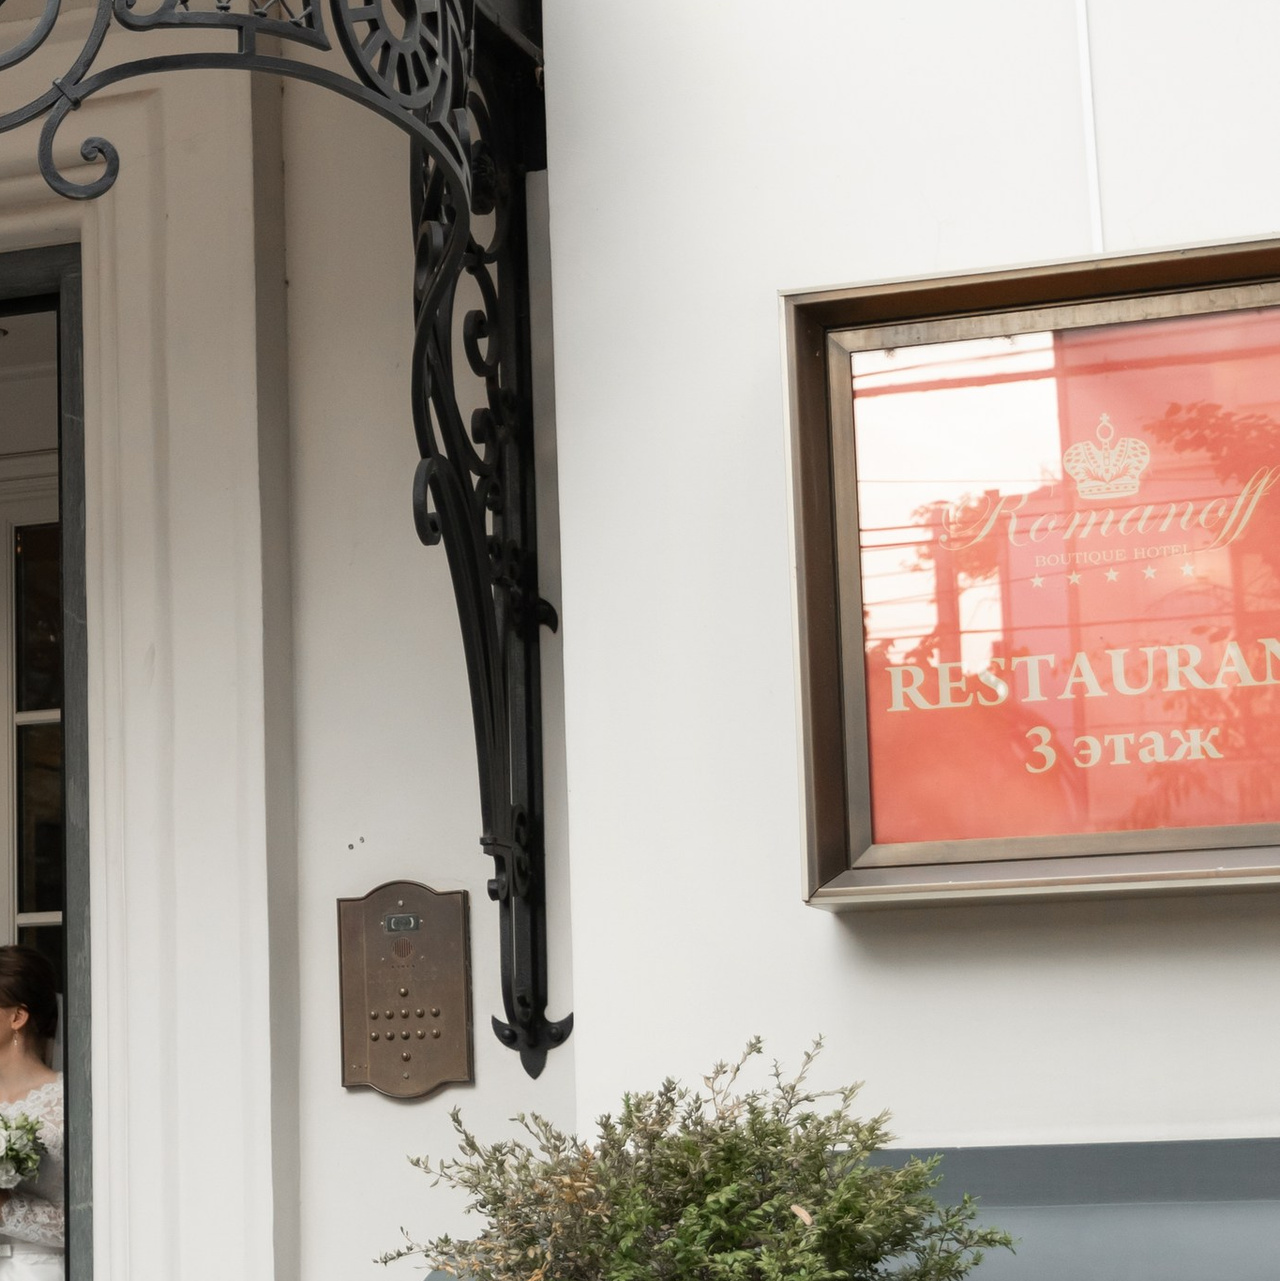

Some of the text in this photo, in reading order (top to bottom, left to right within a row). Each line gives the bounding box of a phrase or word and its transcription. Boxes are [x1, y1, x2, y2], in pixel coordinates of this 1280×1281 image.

[938, 464, 1280, 552] Romanoff
[1035, 543, 1192, 568] BOUTIQUE HOTEL
[1024, 725, 1225, 774] 3 этаж
